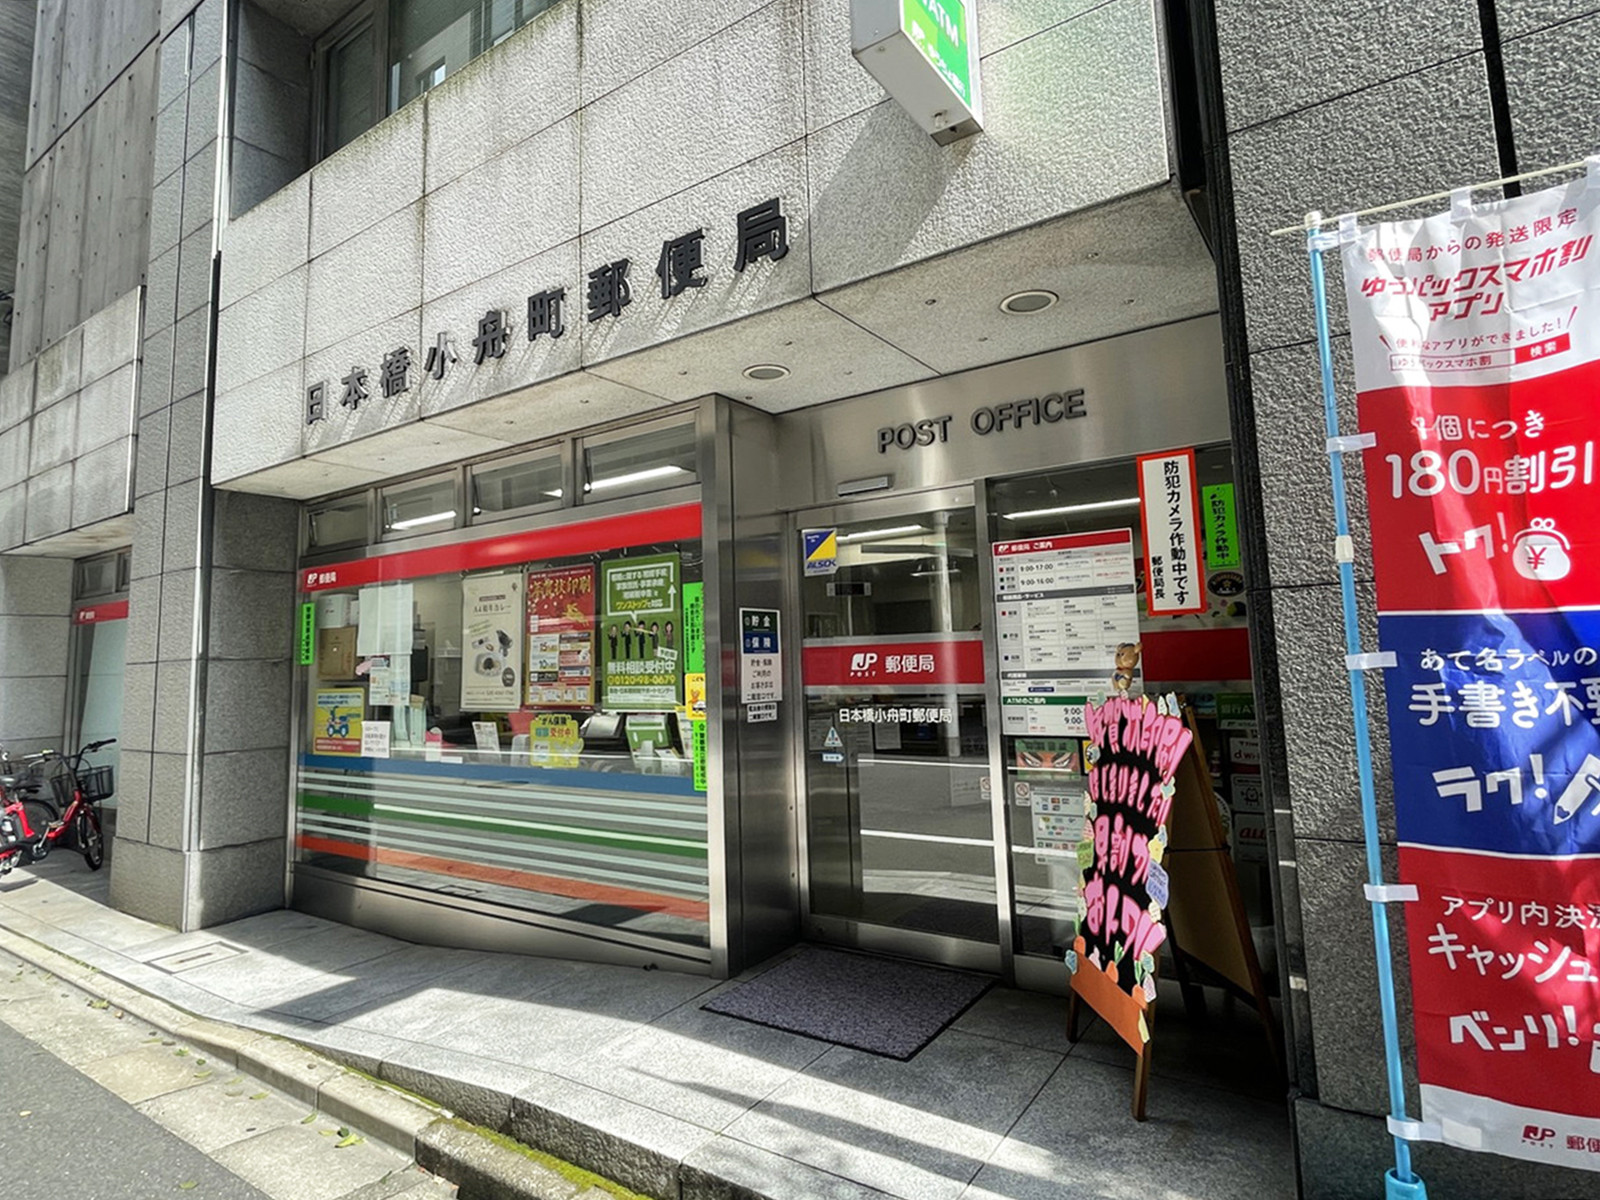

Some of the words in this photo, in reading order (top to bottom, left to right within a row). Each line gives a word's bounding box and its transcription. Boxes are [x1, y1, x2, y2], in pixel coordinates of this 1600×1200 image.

[1366, 207, 1577, 263] 郵便局からの発送限定
[1361, 235, 1593, 297] ゆうパックスマホ割
[305, 197, 788, 425] 日本橋小舟町郵便局
[1429, 292, 1504, 322] アプリ
[1530, 341, 1557, 356] 検索
[877, 415, 952, 453] POST
[970, 388, 1087, 436] OFFICE
[1415, 410, 1544, 441] 1個につき
[1385, 441, 1594, 499] 180円割引
[1164, 461, 1190, 606] 防犯カメラ作動中です
[1418, 512, 1509, 575] トク!
[806, 560, 837, 569] ALSOK
[1151, 556, 1165, 599] 郵便局長
[885, 655, 935, 673] 郵便局
[1420, 646, 1597, 672] あて名ラベルの
[839, 708, 953, 723] 日本橋小舟町郵便局
[1432, 754, 1548, 812] ラク!
[1428, 923, 1599, 984] キャッシュ
[1449, 1005, 1580, 1052] ベンリ!
